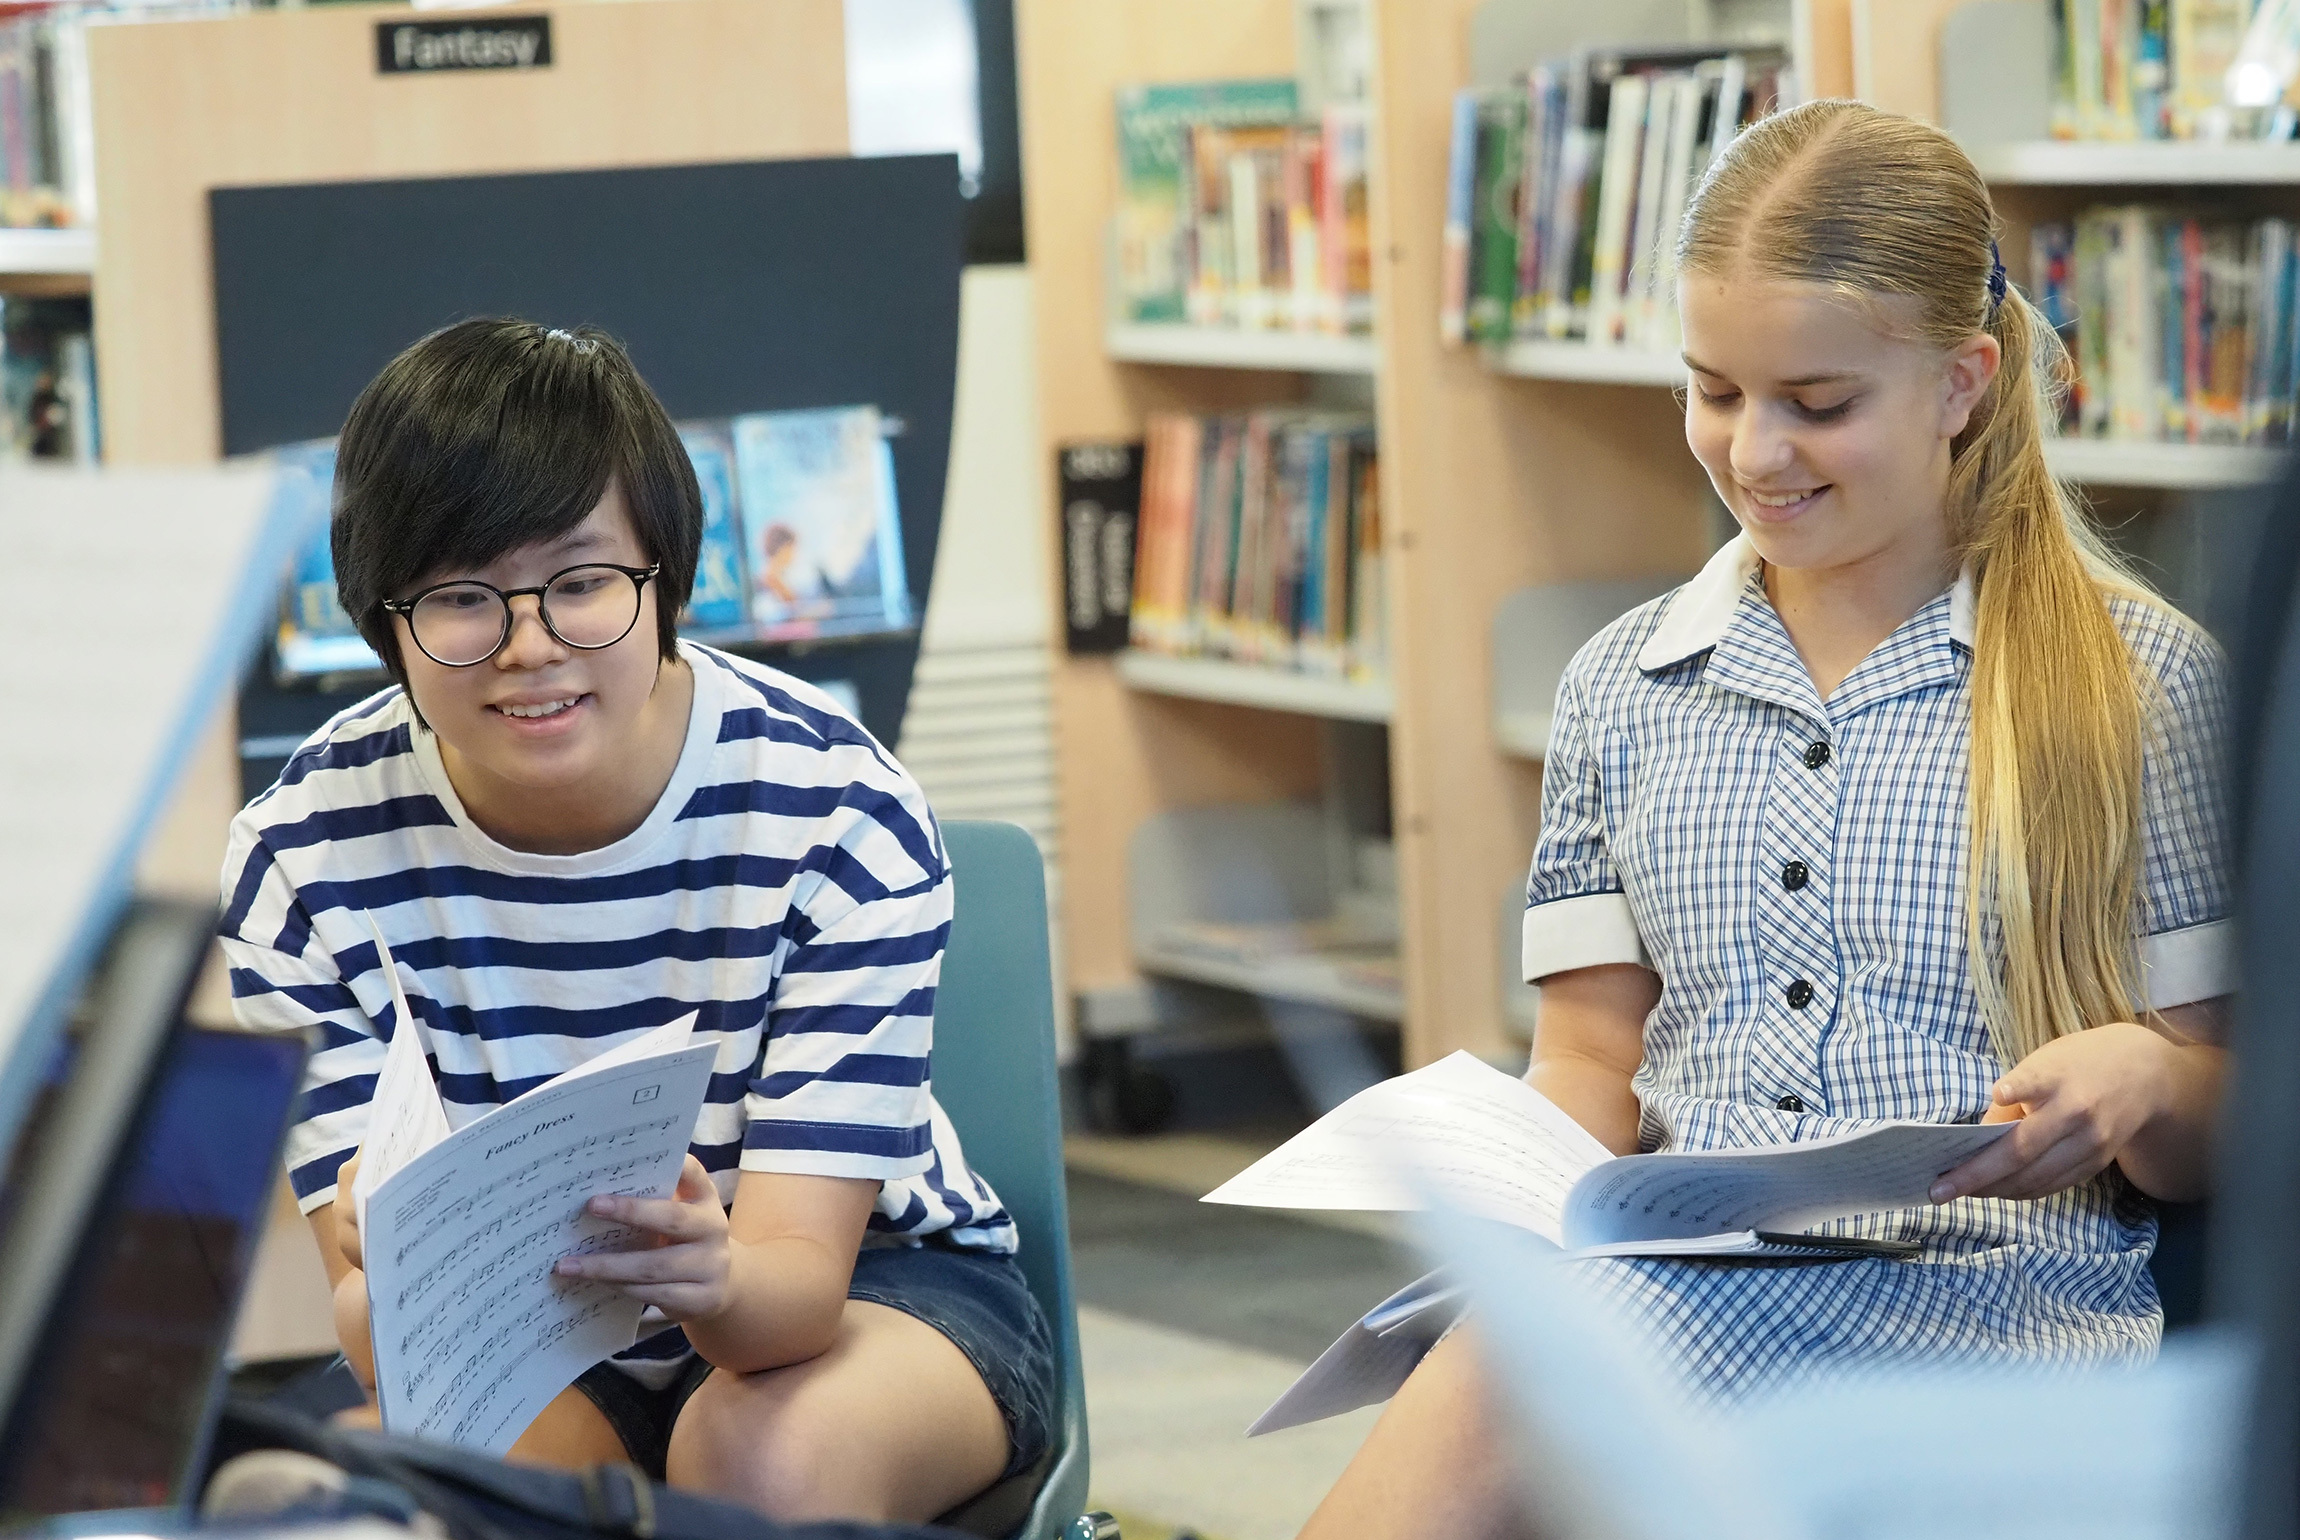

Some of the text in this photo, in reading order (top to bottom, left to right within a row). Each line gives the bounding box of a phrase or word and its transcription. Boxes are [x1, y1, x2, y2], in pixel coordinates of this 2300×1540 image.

[394, 25, 540, 69] Fantasy
[485, 1132, 529, 1160] Fancy
[533, 1112, 575, 1135] Dress
